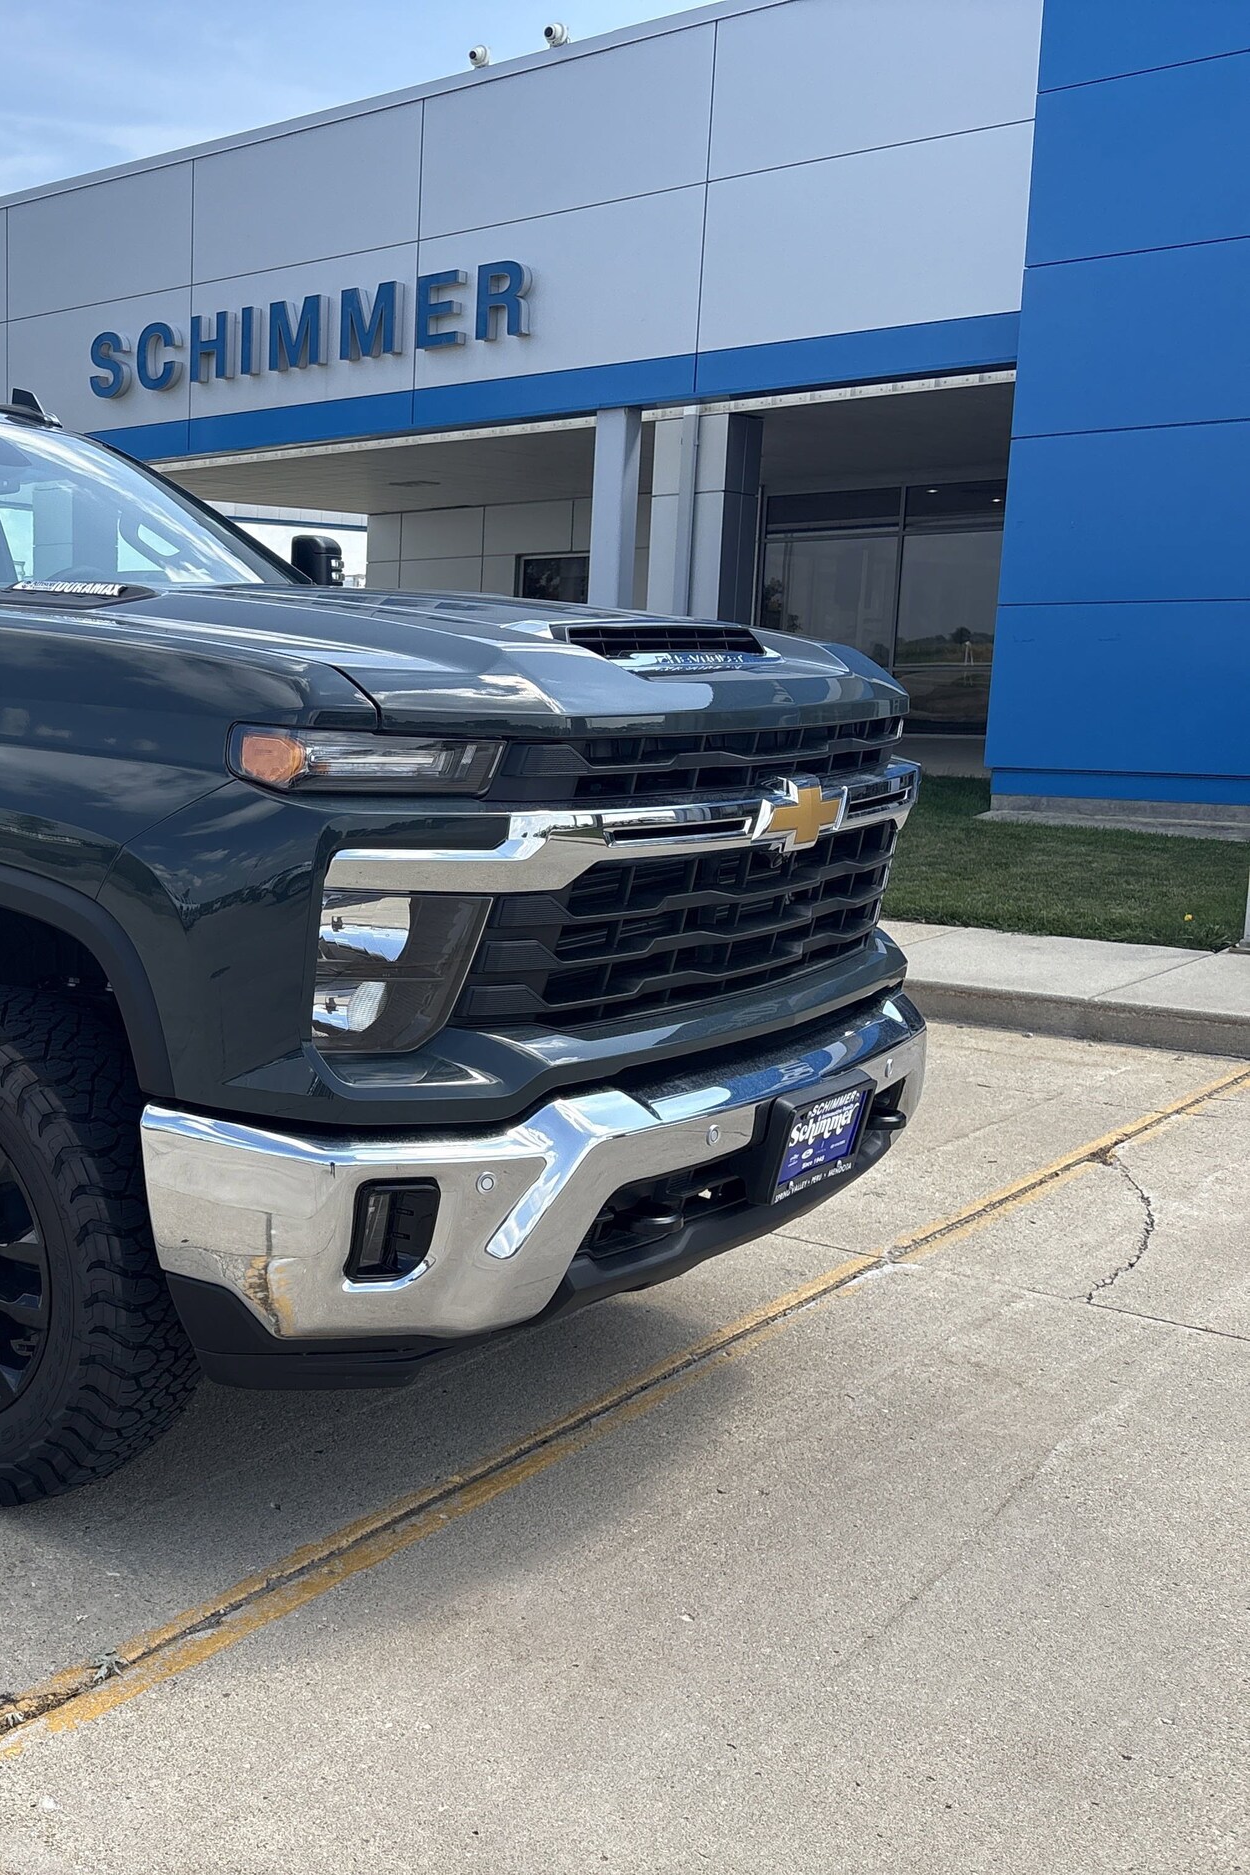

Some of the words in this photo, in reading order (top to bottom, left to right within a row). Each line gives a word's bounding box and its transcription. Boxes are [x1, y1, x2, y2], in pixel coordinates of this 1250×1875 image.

[90, 260, 533, 399] SCHIMMER
[54, 580, 126, 596] DURAMAX
[811, 1090, 857, 1117] SCHIMMER
[789, 1102, 860, 1147] Schimmer
